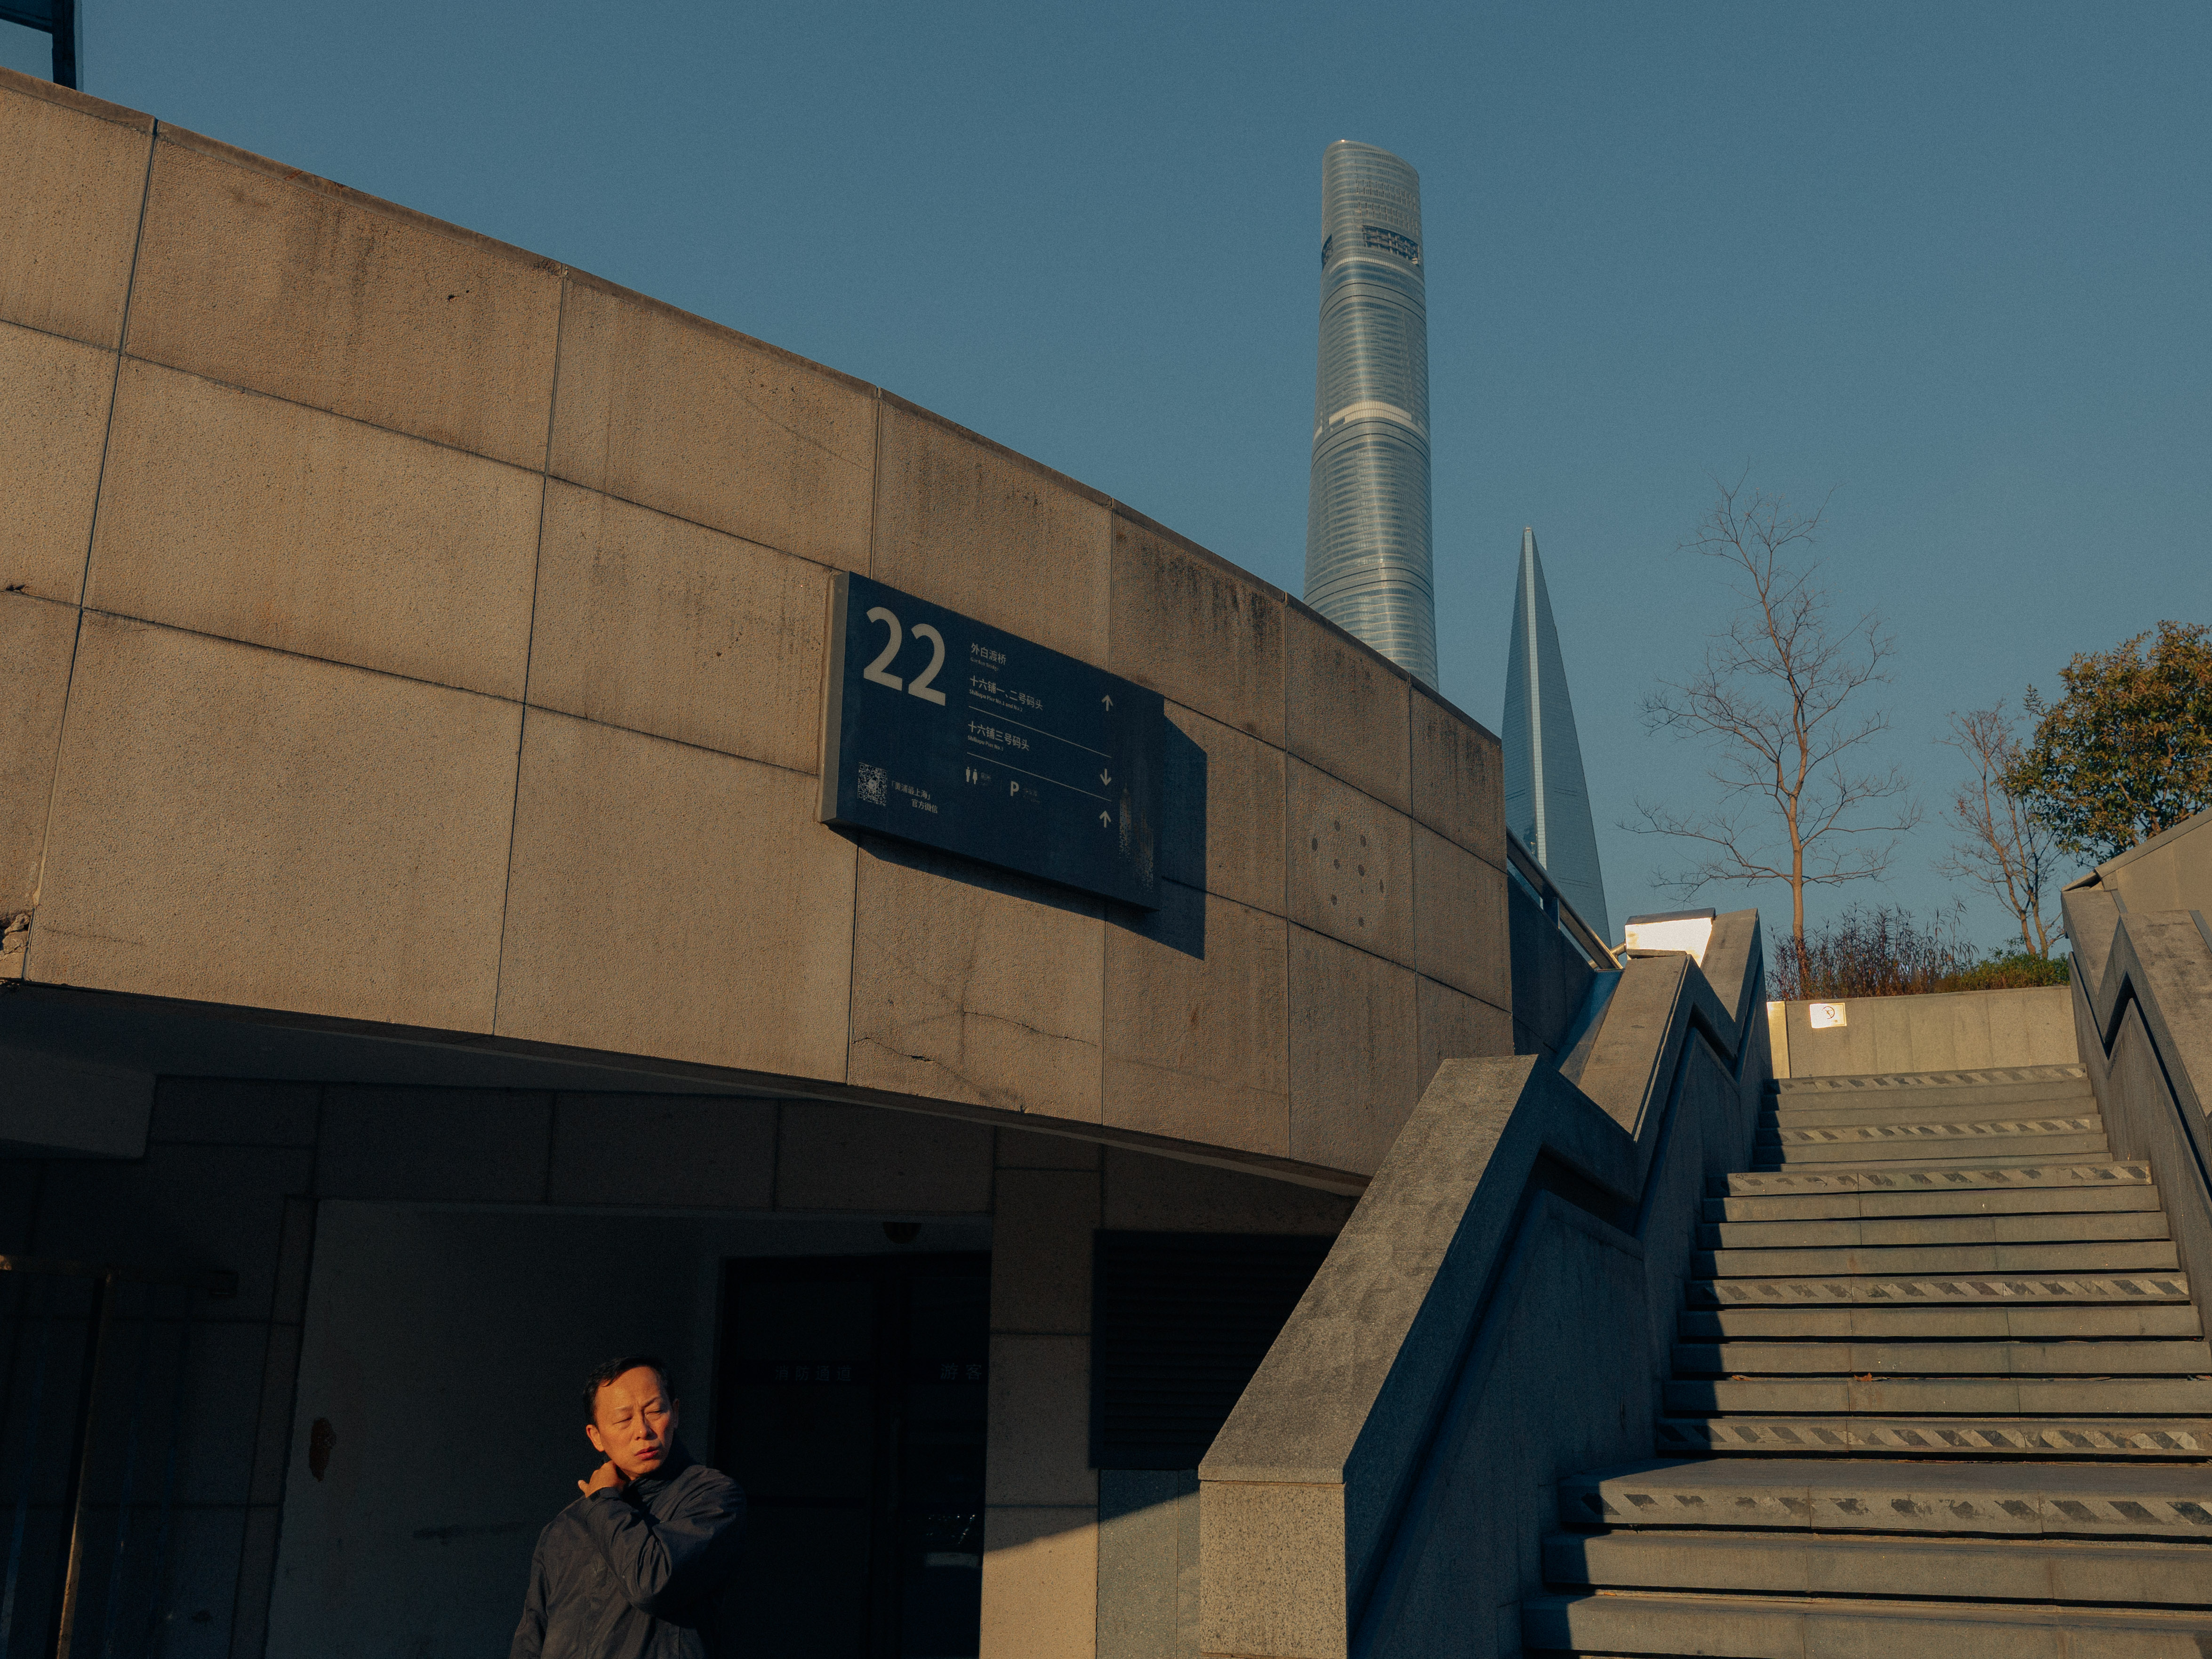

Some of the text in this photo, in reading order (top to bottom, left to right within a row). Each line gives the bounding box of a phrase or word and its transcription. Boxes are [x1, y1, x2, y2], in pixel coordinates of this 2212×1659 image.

[863, 606, 946, 706] 22
[971, 642, 1006, 665] 外白渡桥
[970, 675, 1043, 711] 十六铺一、二号码头
[986, 695, 995, 703] Pier
[968, 721, 1030, 751] 十六铺三号码头
[1010, 780, 1019, 797] P
[912, 798, 938, 814] 官方微信
[775, 1364, 852, 1381] 消防通道
